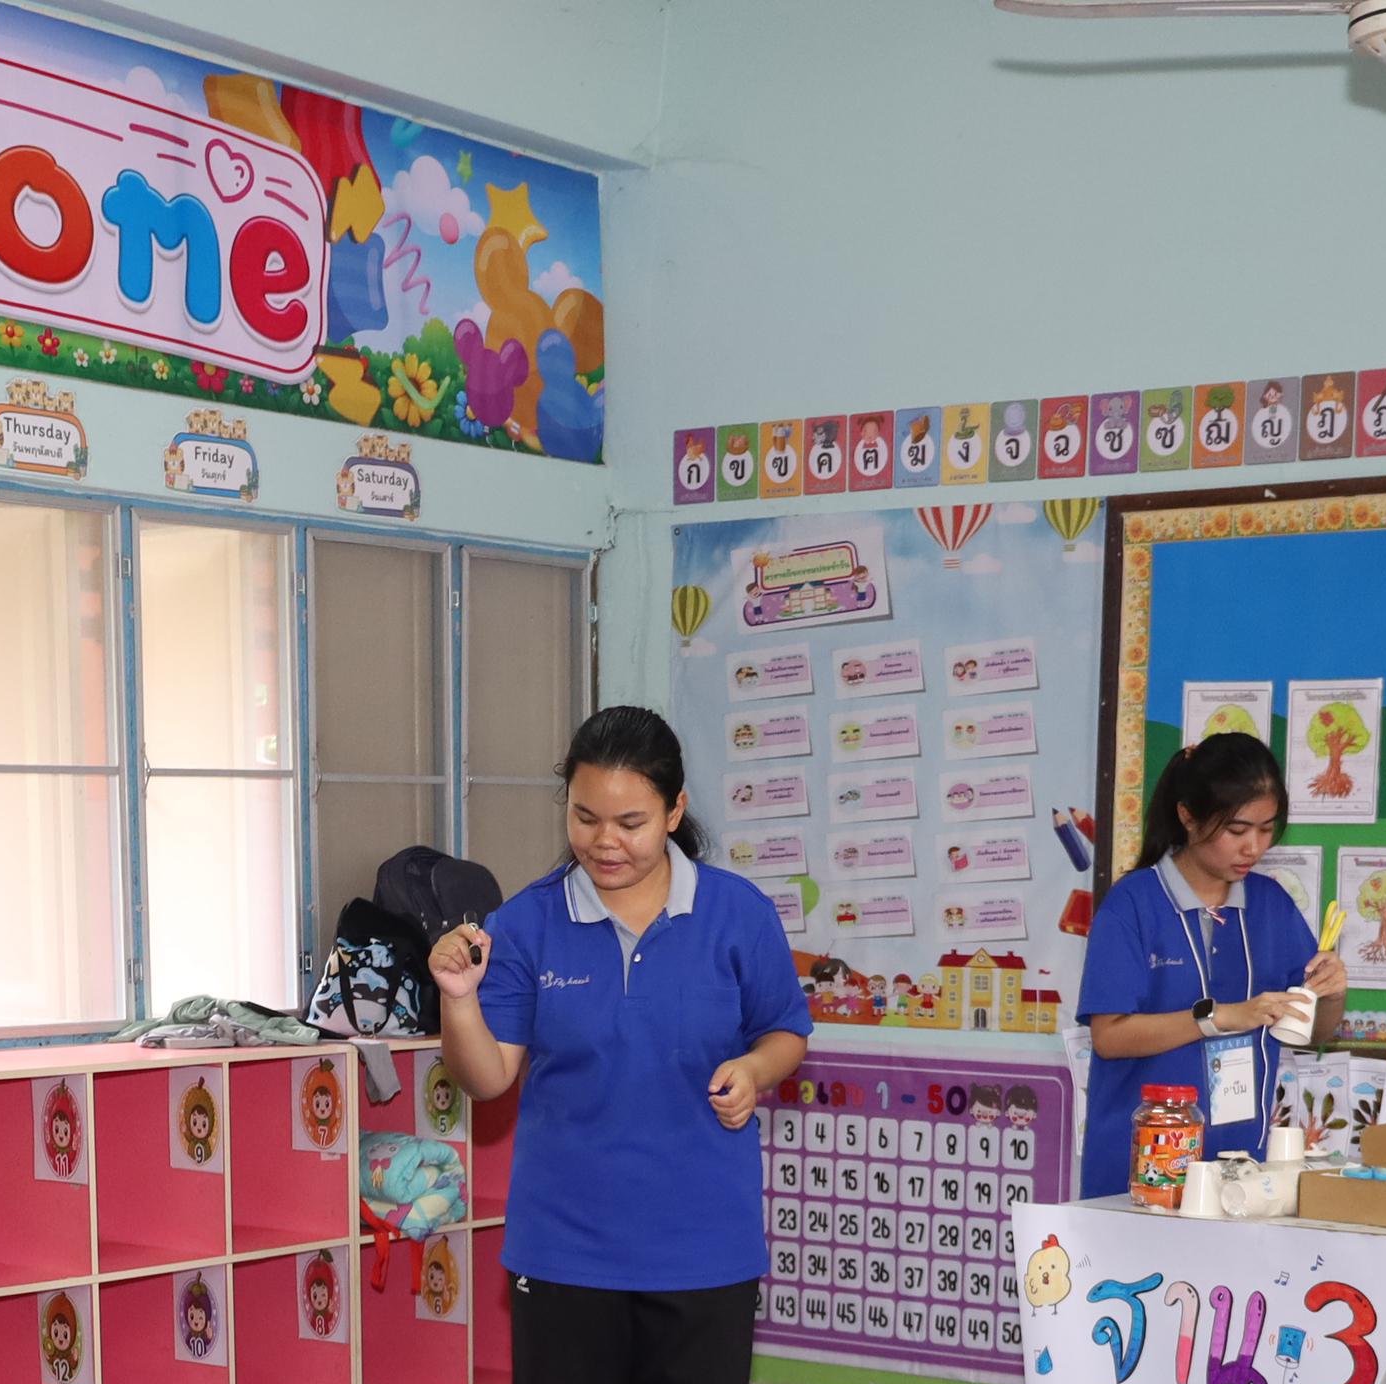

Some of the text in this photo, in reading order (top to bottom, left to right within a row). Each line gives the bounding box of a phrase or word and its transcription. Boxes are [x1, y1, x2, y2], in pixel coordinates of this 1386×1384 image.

[3, 417, 71, 444] Thursday
[1261, 419, 1282, 445] ญ
[1319, 406, 1334, 438] ฎ
[1104, 430, 1123, 451] ช
[1155, 425, 1175, 447] ซ
[1206, 421, 1231, 445] ฌ
[13, 441, 63, 460] วันพฤหัสบดี
[909, 445, 926, 466] ฆ
[960, 443, 969, 462] ง
[1006, 439, 1019, 460] จ
[1054, 435, 1070, 456] ฉ
[194, 446, 234, 468] Friday
[817, 453, 833, 473] ค
[357, 468, 408, 490] Saturday
[687, 462, 701, 484] ก
[730, 458, 746, 480] ข
[1210, 1038, 1249, 1051] STAFF
[877, 1082, 888, 1109] 1
[928, 1084, 966, 1115] 50
[439, 1116, 446, 1133] 5
[318, 1127, 327, 1146] 7
[784, 1119, 1029, 1161] 3 4 5 6 7 8 9 10
[1170, 1130, 1200, 1151] Yupi
[195, 1146, 204, 1163] 9
[55, 1155, 69, 1176] 11
[780, 1163, 1028, 1205] 13 14 15 16 17 18 19 20
[777, 1207, 992, 1251] 23 24 25 26 27 28 29
[777, 1251, 991, 1296] 33 34 35 36 37 38 39
[435, 1297, 441, 1314] 6
[316, 1316, 324, 1335] 8
[775, 1295, 1021, 1345] 43 44 45 46 47 48 49 50
[190, 1338, 204, 1356] 10
[54, 1360, 69, 1382] 12
